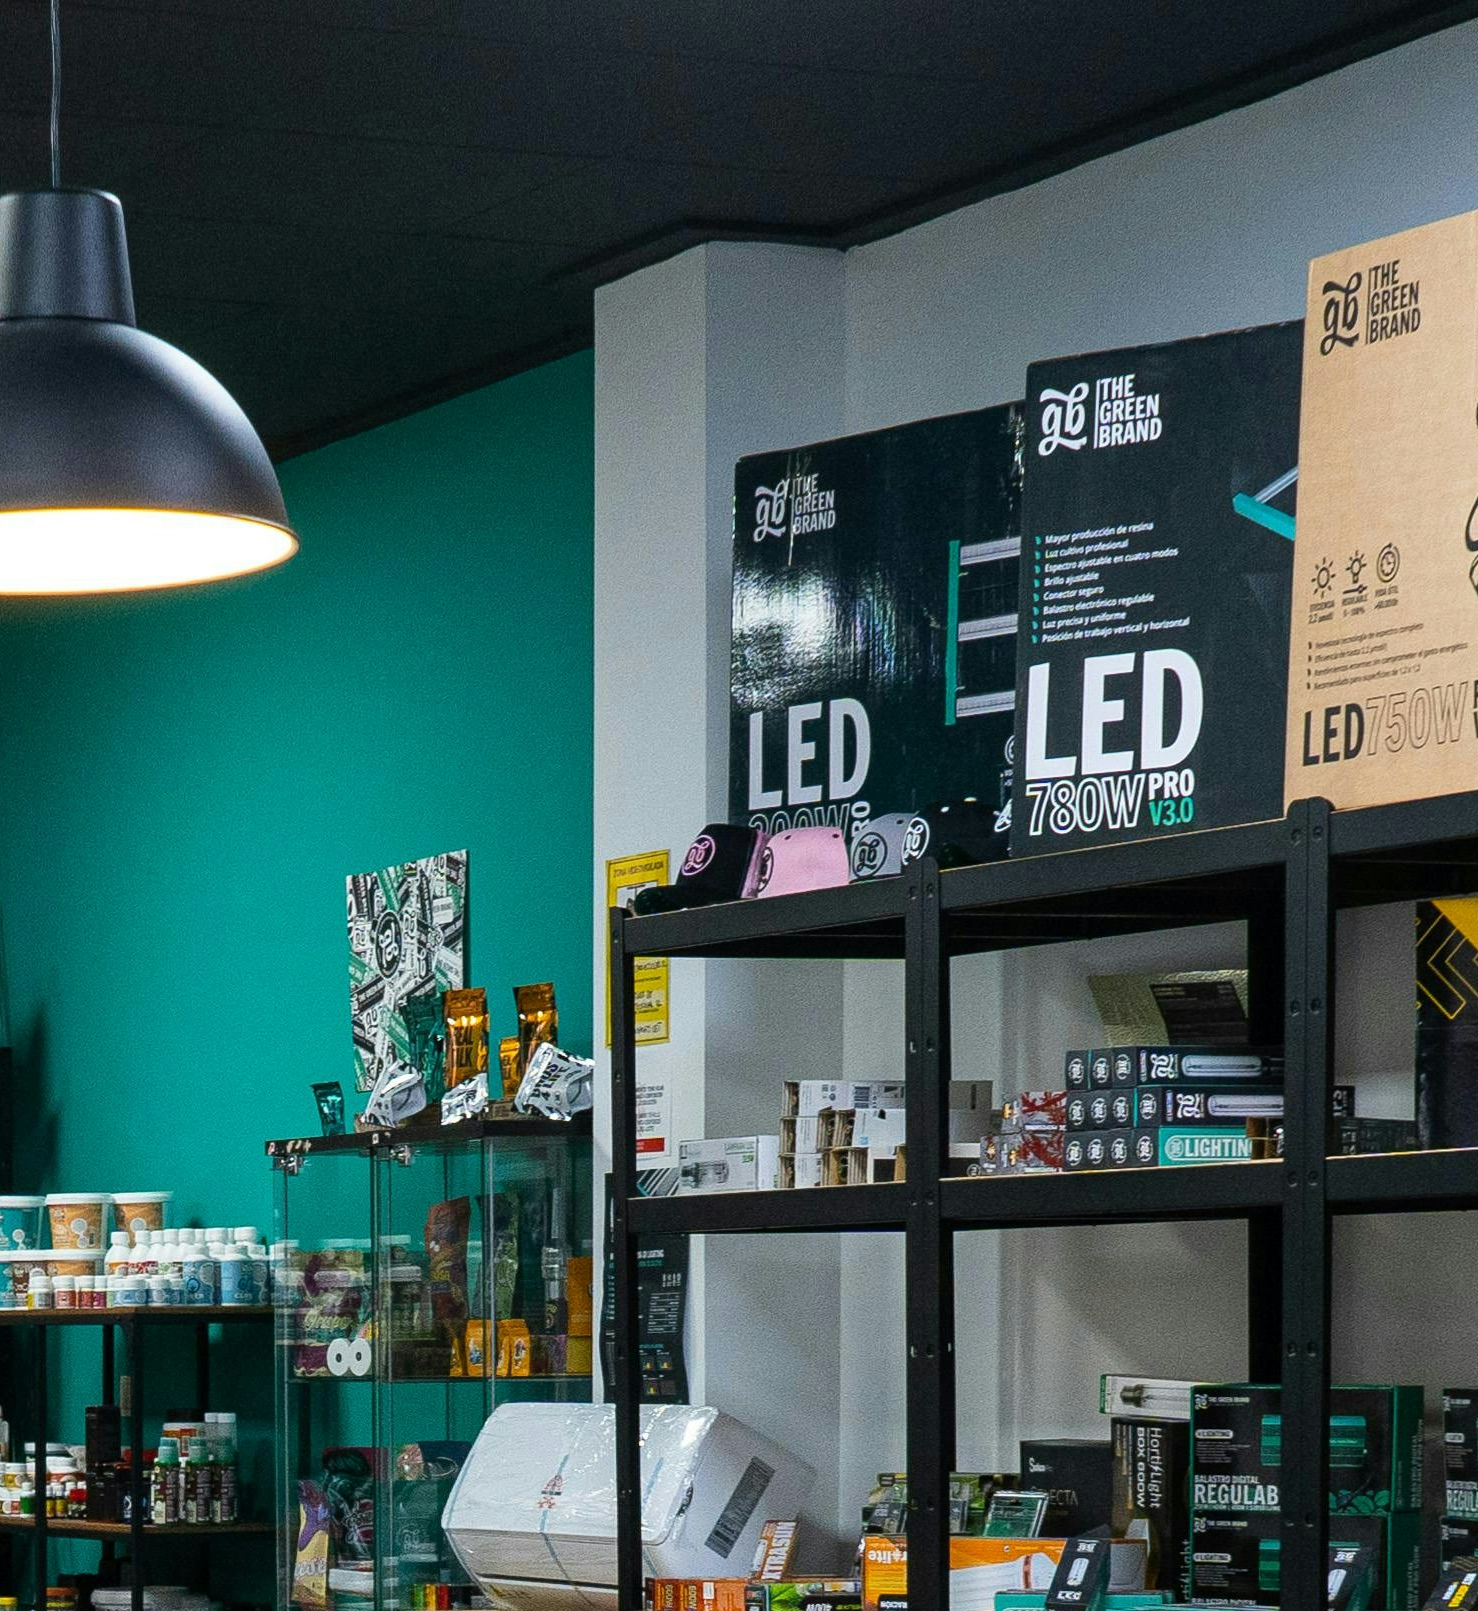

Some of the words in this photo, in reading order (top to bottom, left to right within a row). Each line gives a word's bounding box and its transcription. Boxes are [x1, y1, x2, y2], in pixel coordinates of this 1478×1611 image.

[1374, 259, 1400, 290] THE
[1370, 281, 1419, 317] GREEN
[1369, 308, 1421, 343] BRAND
[1100, 374, 1135, 400] THE
[1099, 394, 1160, 425] GREEN
[1098, 418, 1162, 448] BRAND
[795, 473, 818, 495] THE
[793, 491, 835, 516] GREEN
[793, 509, 835, 535] BRAND
[1116, 525, 1127, 534] de
[1025, 648, 1204, 780] LED
[748, 698, 871, 811] LED
[1147, 769, 1195, 800] PRO
[1024, 773, 1146, 836] 780W
[1148, 797, 1195, 828] V3.0
[1194, 1474, 1230, 1485] BALASTRO
[1231, 1475, 1259, 1484] DIGITAL
